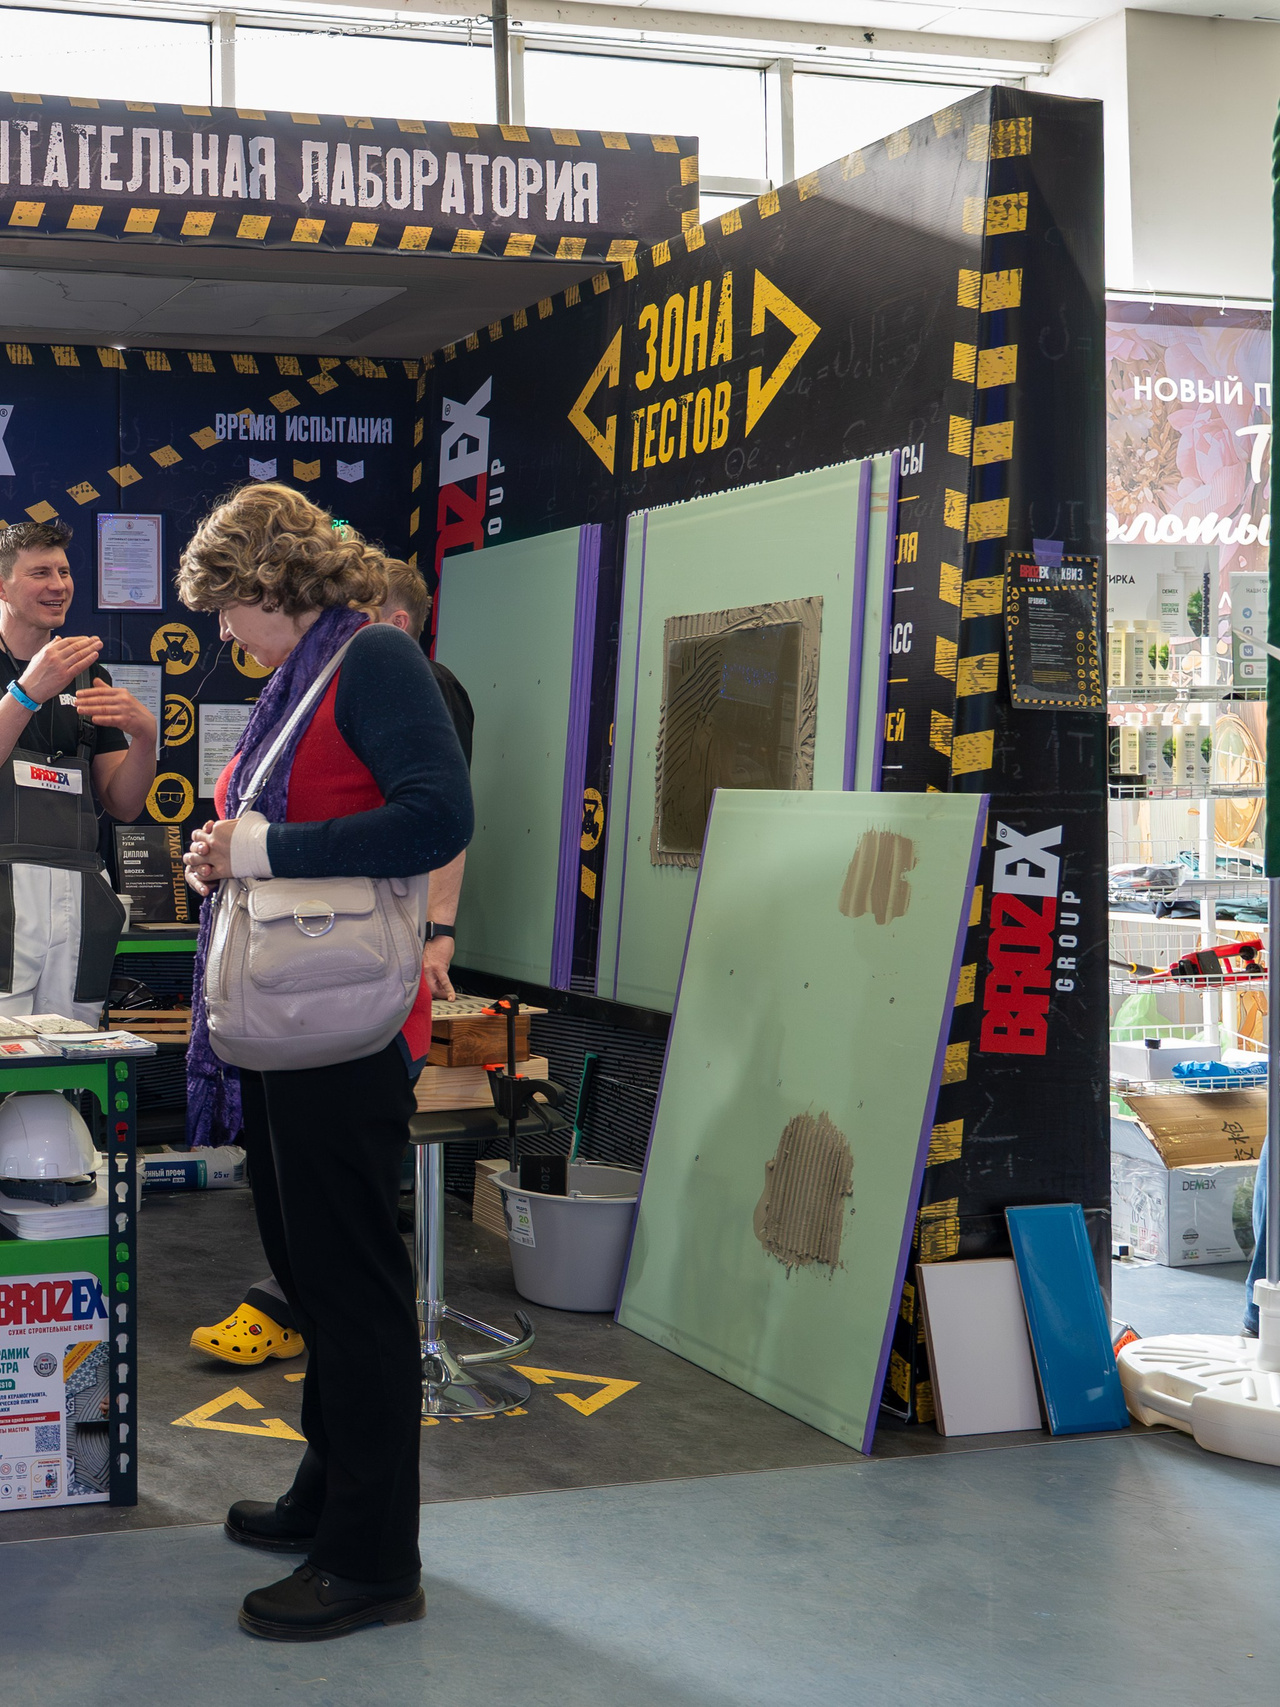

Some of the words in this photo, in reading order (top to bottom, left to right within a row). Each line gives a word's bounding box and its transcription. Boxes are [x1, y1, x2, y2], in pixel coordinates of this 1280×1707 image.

[297, 140, 599, 223] ЛАБОРАТОРИЯ
[635, 270, 733, 392] ЗОНА
[1133, 375, 1244, 405] НОВЫЙ
[215, 413, 276, 441] ВРЕМЯ
[285, 415, 393, 444] ИСПЫТАНИЯ
[631, 380, 733, 472] ТЕСТОВ
[1020, 564, 1050, 579] BROZEX
[1061, 567, 1083, 581] КВИЗ
[30, 765, 70, 787] BROZEX
[123, 850, 149, 859] ДИПЛОМ
[167, 826, 182, 859] РУКИ
[172, 861, 188, 921] ЗОЛОТЫЕ
[979, 820, 1063, 1056] BROZEX
[1055, 890, 1081, 992] GROUP
[166, 1168, 186, 1177] ПРОФИ
[213, 1171, 223, 1179] 25
[540, 1166, 550, 1191] 200
[519, 1214, 529, 1224] 20
[8, 1328, 26, 1336] СУХИЕ
[28, 1325, 72, 1334] СТРОИТЕЛЬНЫЕ
